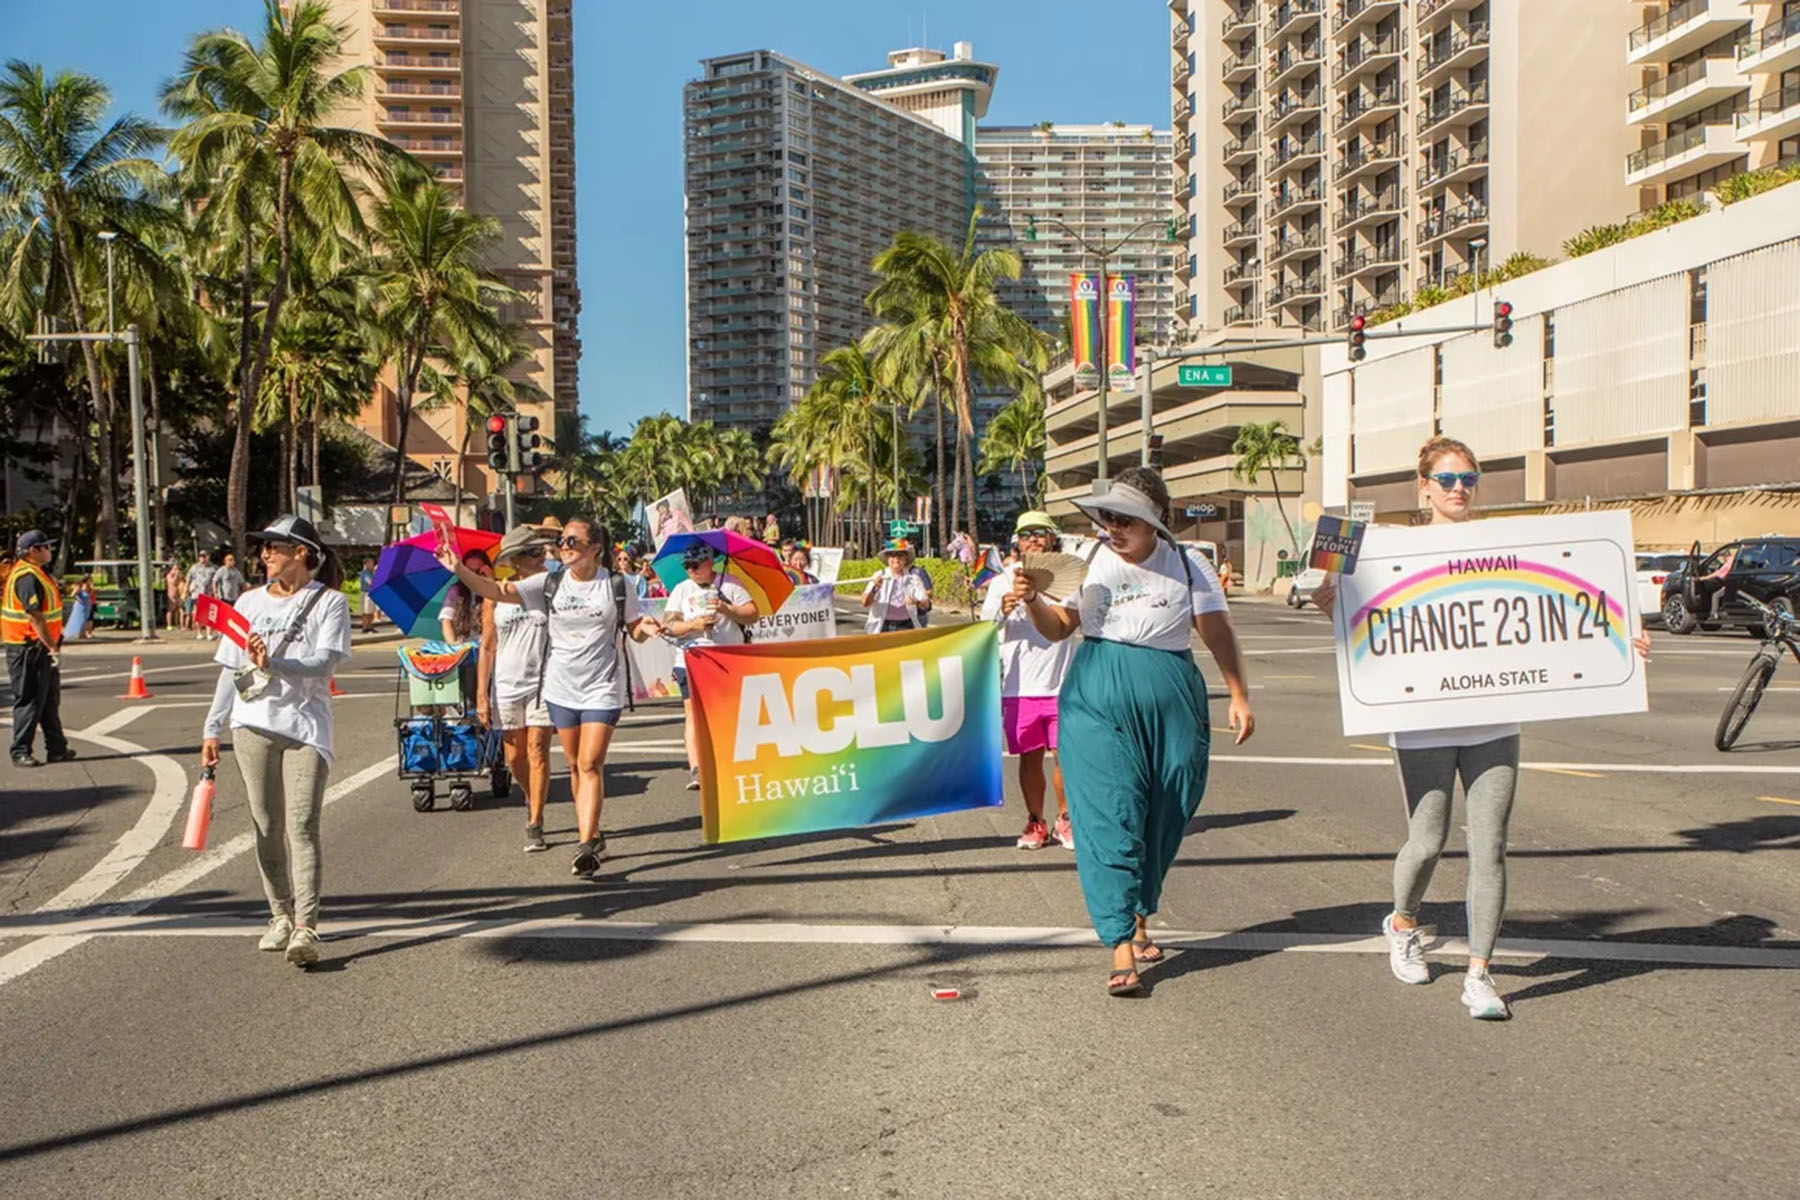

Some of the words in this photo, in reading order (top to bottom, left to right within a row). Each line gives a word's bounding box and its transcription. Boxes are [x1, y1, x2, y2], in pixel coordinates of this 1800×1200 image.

[1185, 370, 1210, 381] ENA
[1315, 540, 1359, 556] PEOPLE
[1448, 555, 1518, 575] HAWAII
[759, 608, 830, 629] EVERYONE!
[1366, 600, 1488, 657] CHANGE
[1493, 596, 1531, 646] 23
[1538, 593, 1568, 642] IN
[1575, 590, 1610, 639] 24
[1440, 672, 1495, 691] ALOHA
[1499, 668, 1549, 687] STATE
[733, 655, 965, 762] ACLU
